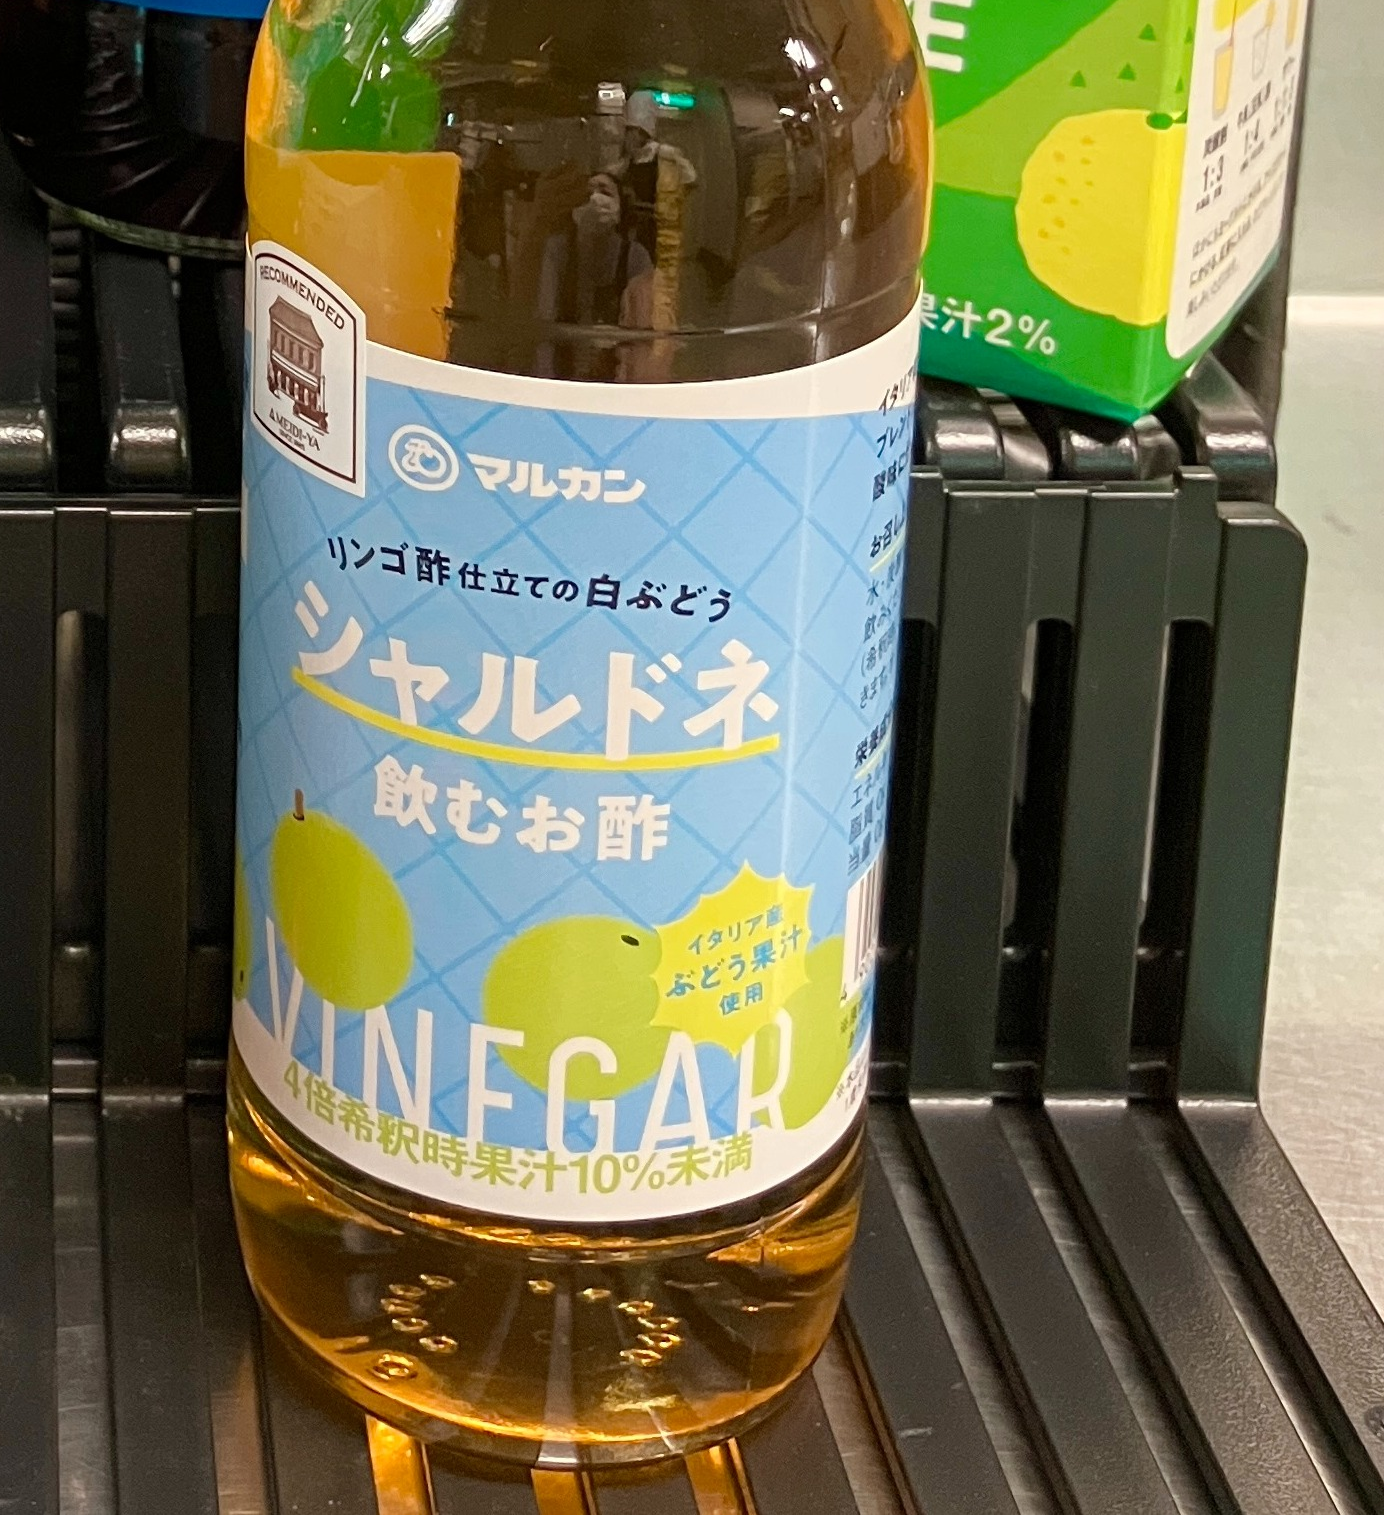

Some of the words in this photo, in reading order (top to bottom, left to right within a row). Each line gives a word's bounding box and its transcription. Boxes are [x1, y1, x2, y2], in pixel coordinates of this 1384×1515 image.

[259, 264, 346, 331] RECOMMENDED
[468, 452, 646, 504] マルカン
[326, 536, 733, 623] リンゴ酢仕立ての白ぶどう
[297, 581, 780, 761] シャルドネ
[374, 756, 672, 863] 飲むお酢
[666, 922, 804, 998] ぶどう果汁
[687, 904, 785, 958] イタリア産
[265, 916, 793, 1157] VINEGAR
[717, 984, 765, 1017] 使用
[284, 1059, 755, 1195] 4倍希釈時果汁10%未満
